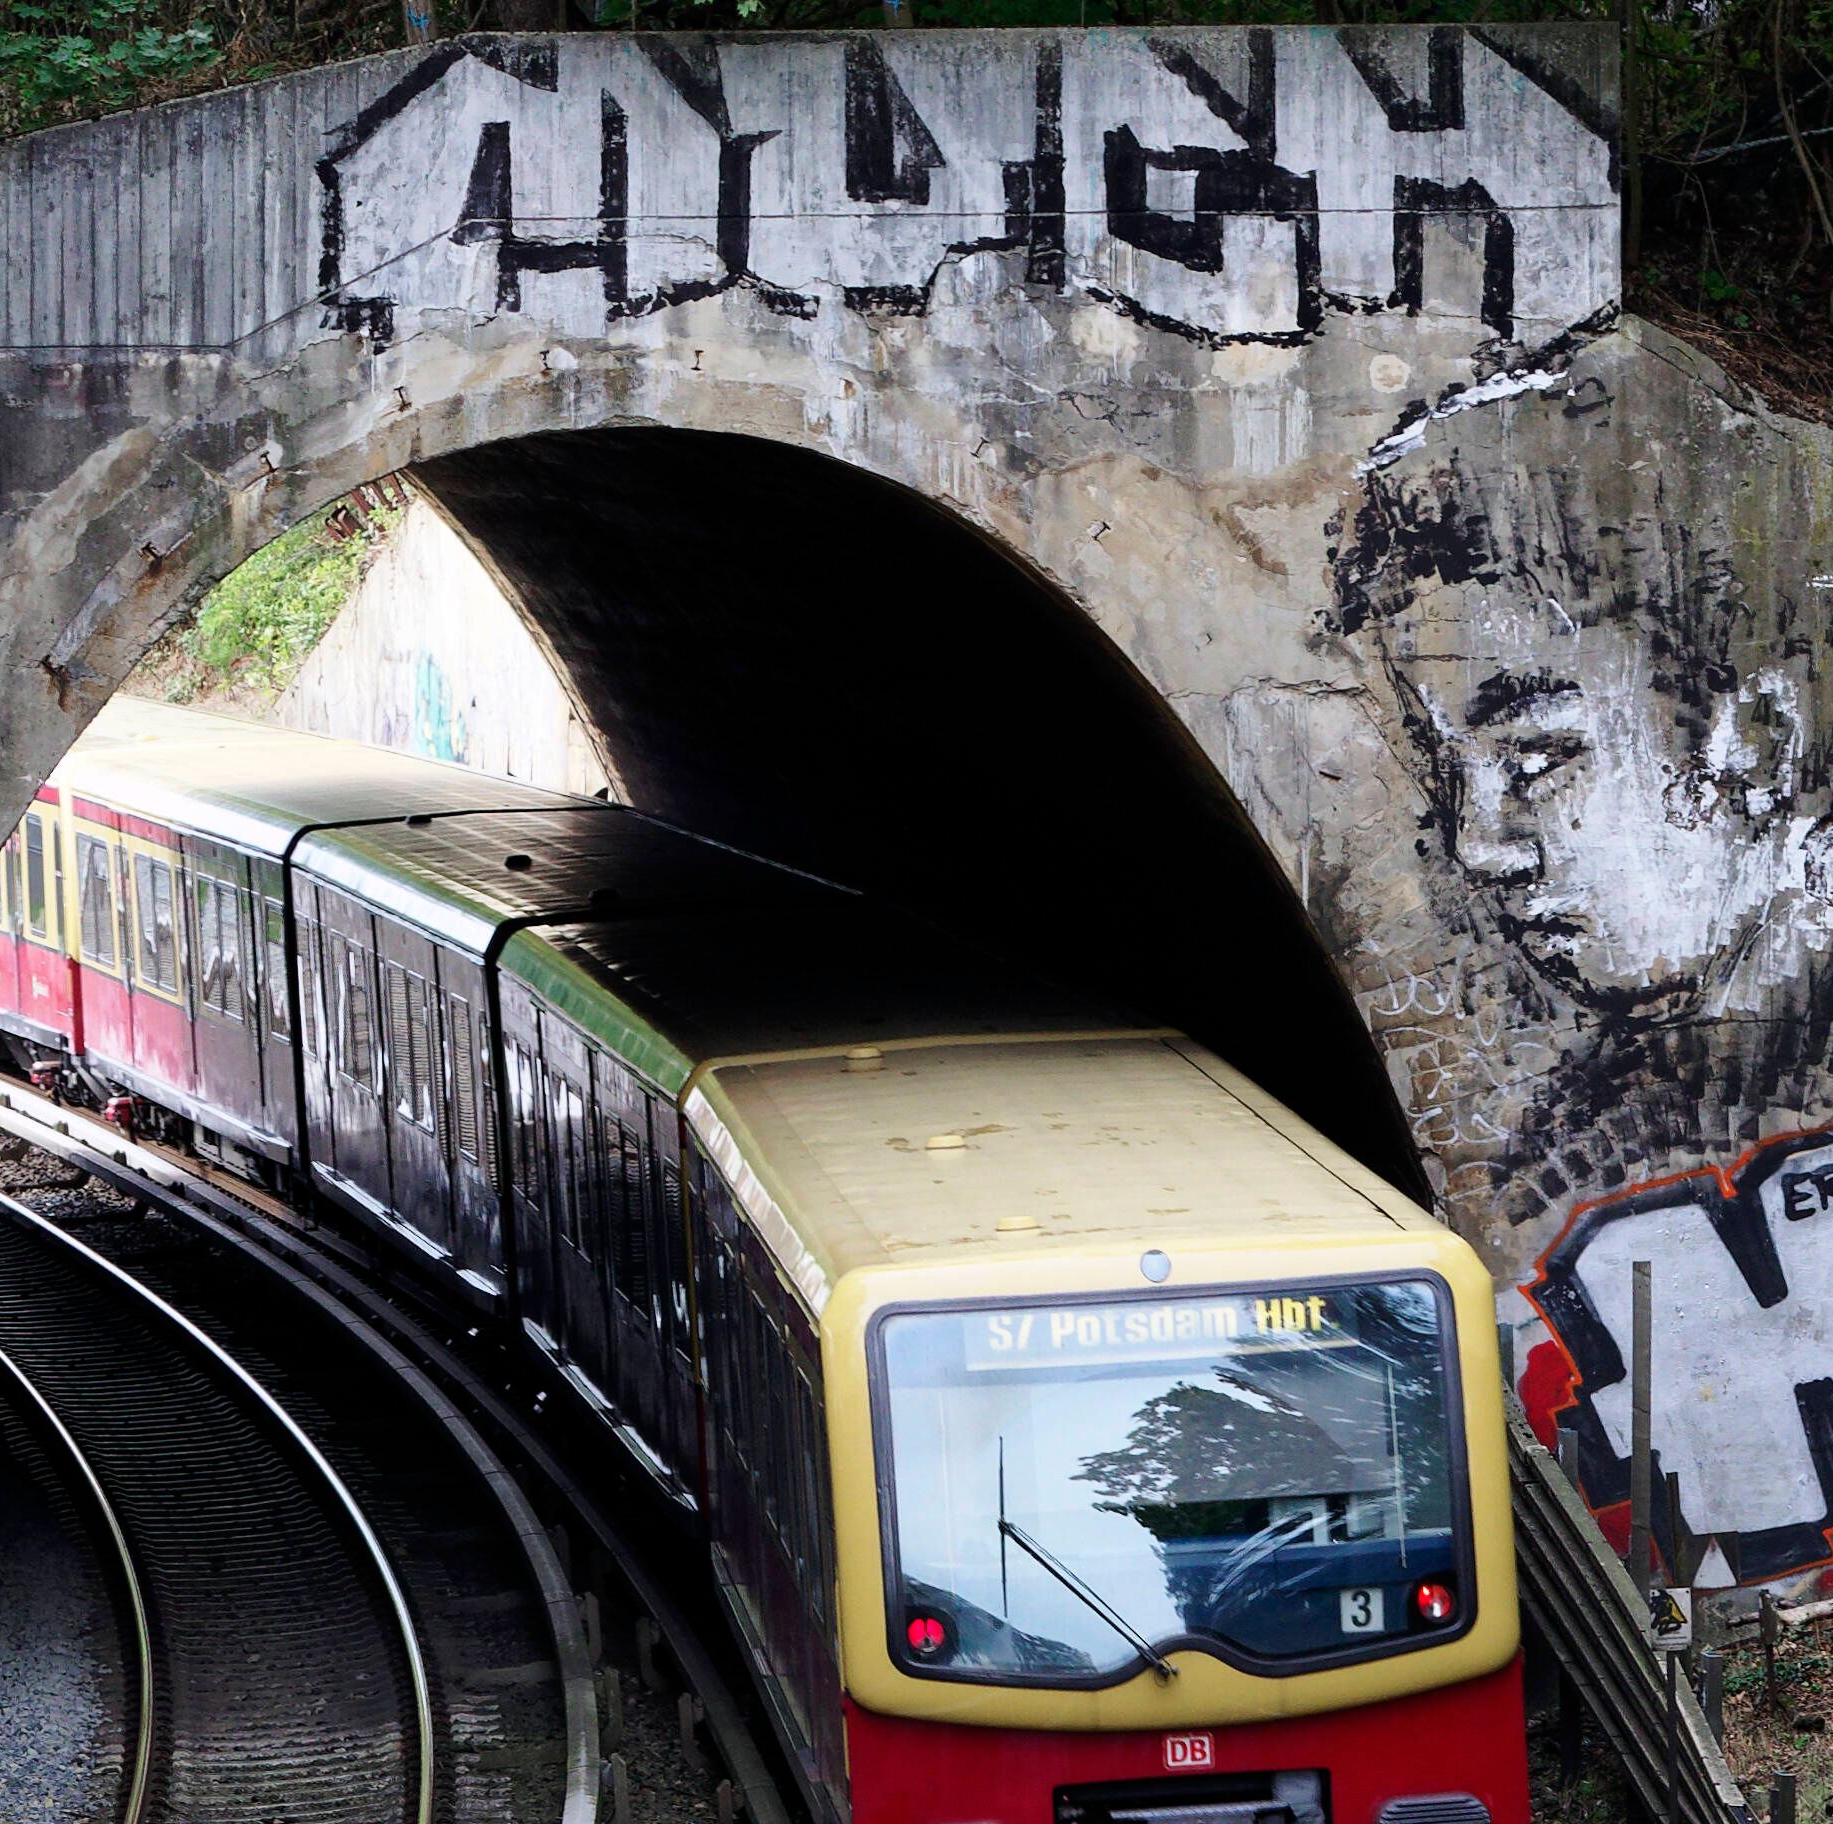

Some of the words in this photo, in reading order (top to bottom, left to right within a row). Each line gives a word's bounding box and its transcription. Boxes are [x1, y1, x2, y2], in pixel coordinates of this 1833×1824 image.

[1050, 1303, 1239, 1349] Potsdam
[1350, 1589, 1372, 1628] 3
[1168, 1737, 1209, 1764] DB
